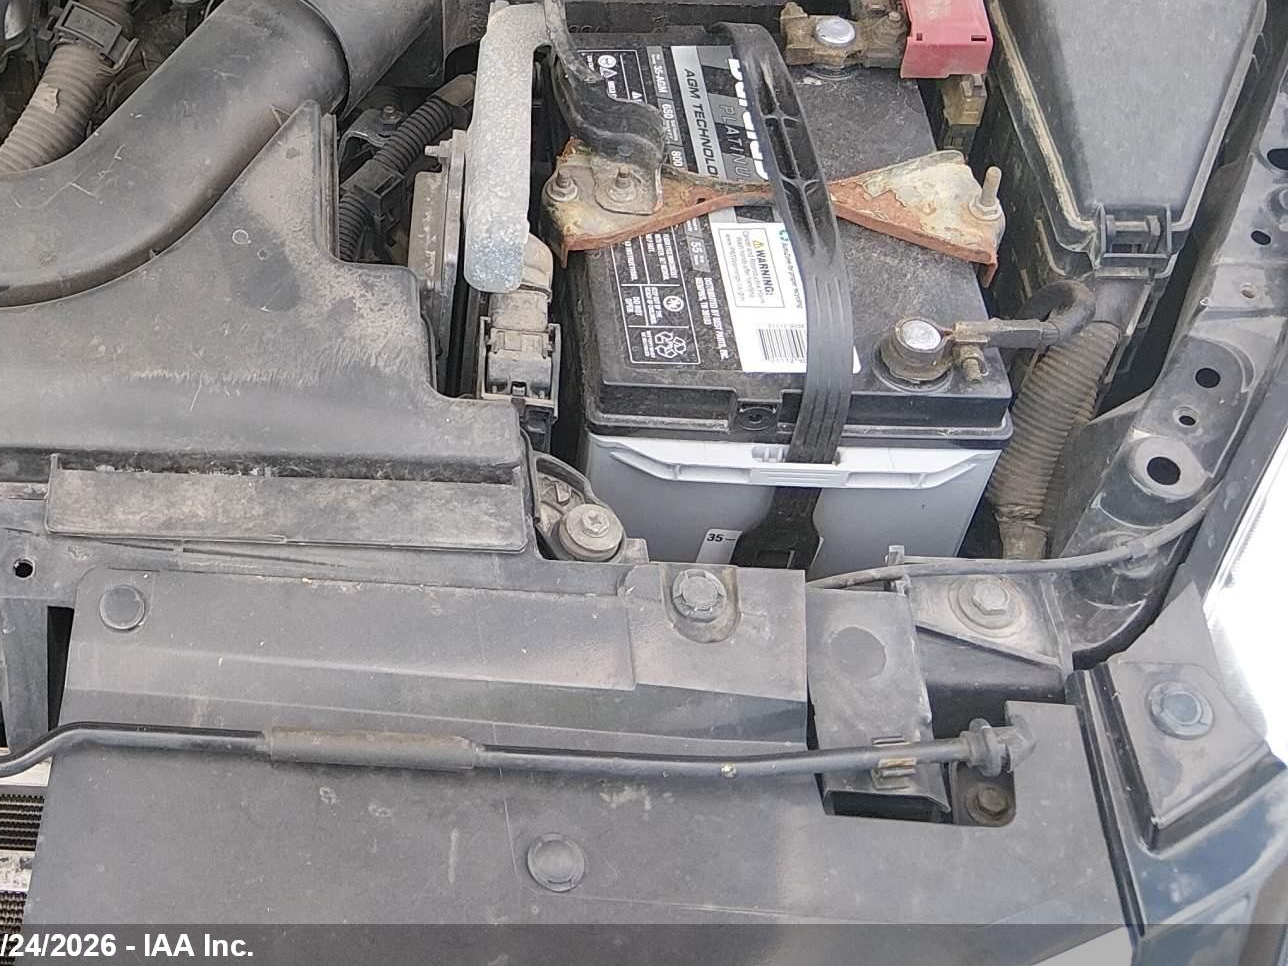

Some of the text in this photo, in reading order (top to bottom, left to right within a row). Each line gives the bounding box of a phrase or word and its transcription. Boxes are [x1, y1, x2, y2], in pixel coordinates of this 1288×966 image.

[654, 65, 667, 92] 35-AGM
[684, 68, 699, 97] AGM
[662, 103, 672, 118] 650
[720, 105, 748, 181] PLATINU
[671, 150, 682, 166] 800
[690, 241, 702, 252] 55
[756, 249, 773, 295] WARNING:
[706, 533, 724, 543] 35
